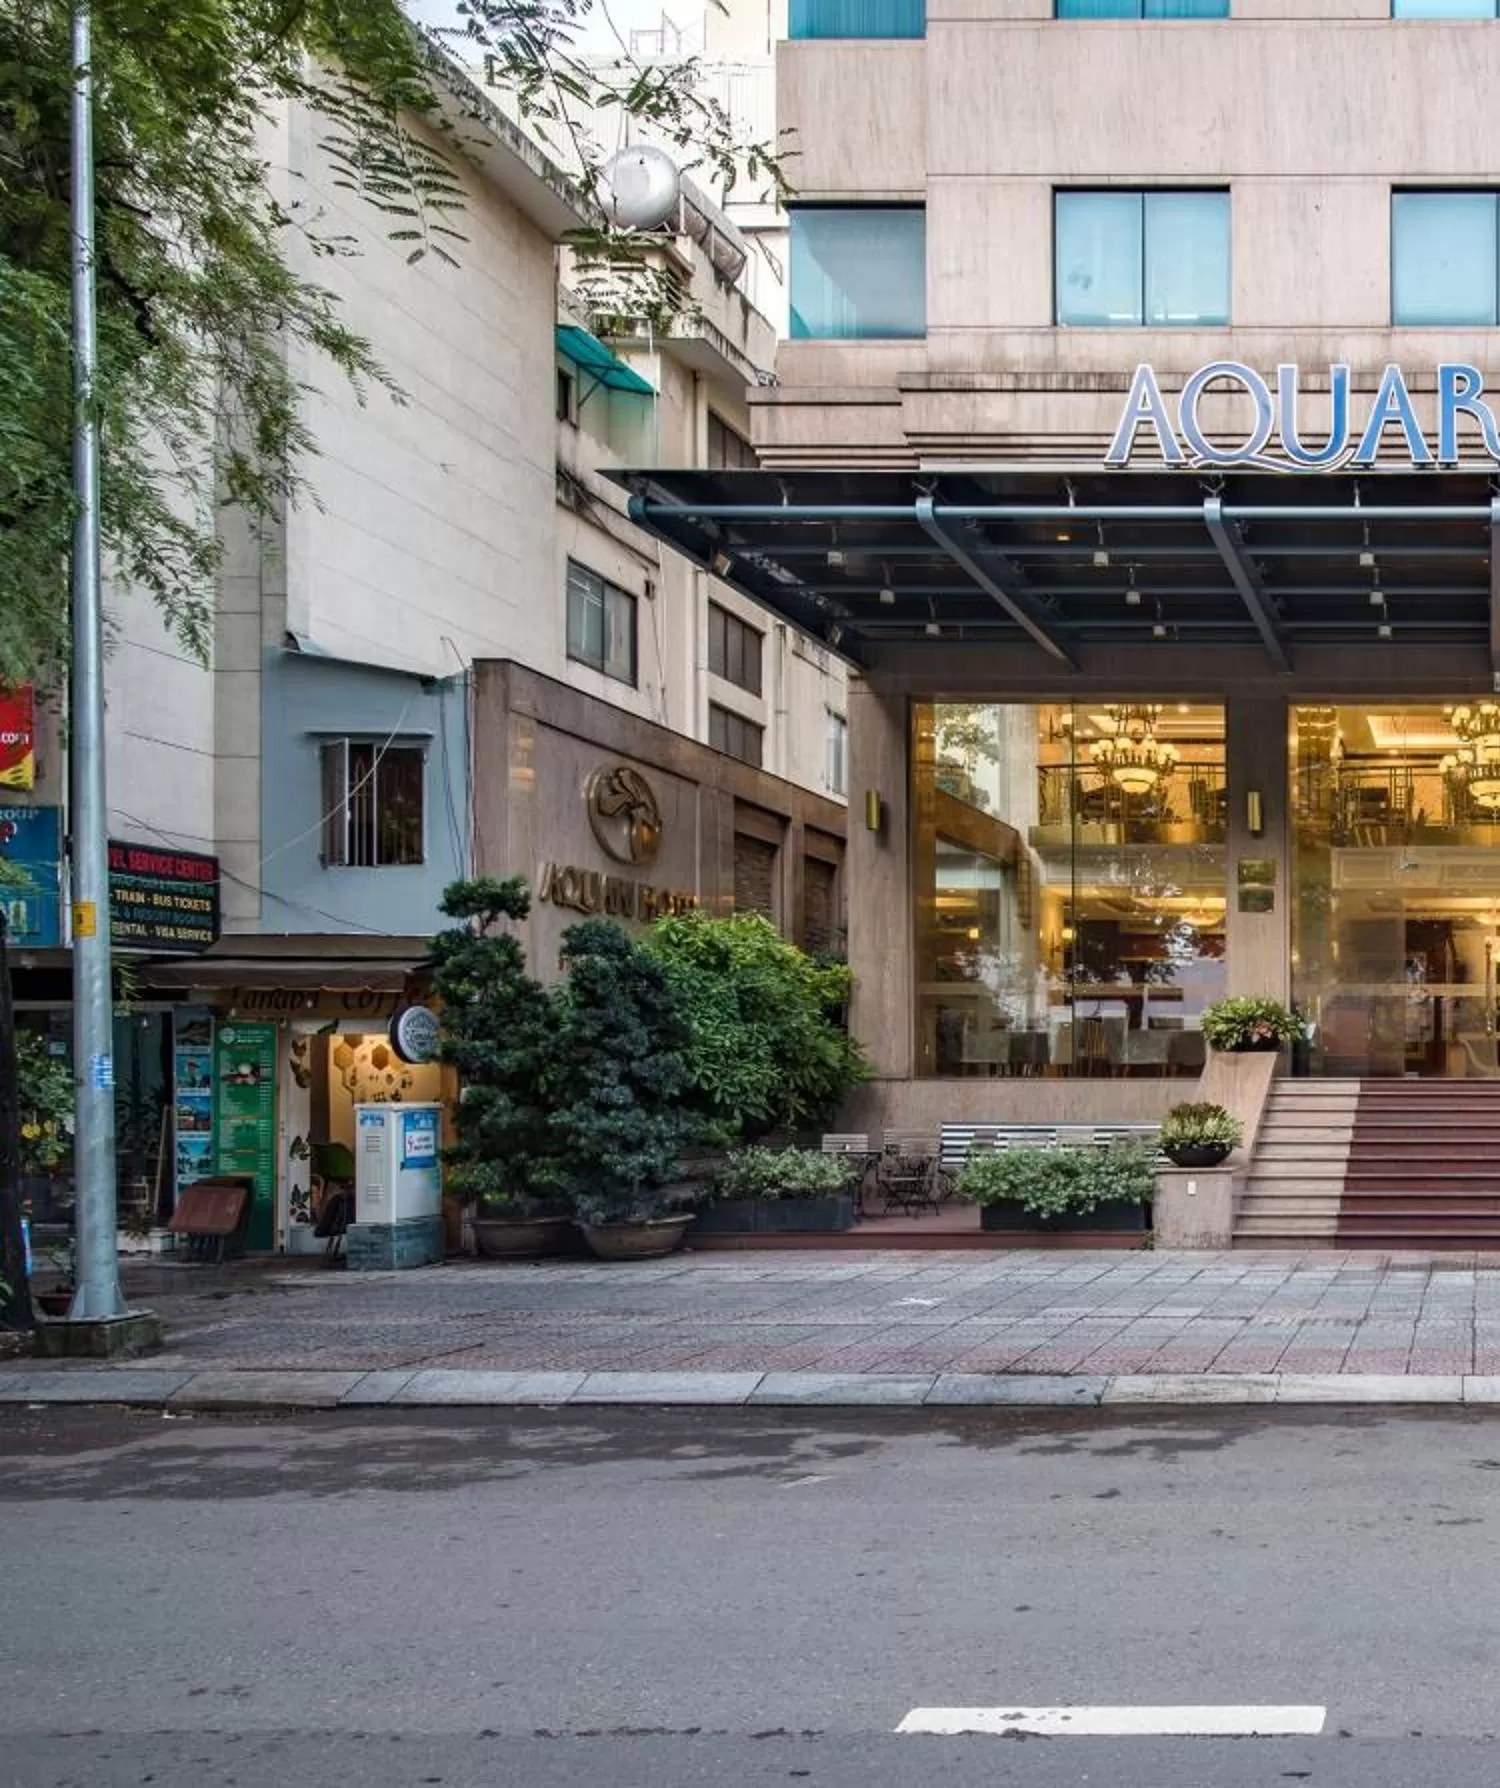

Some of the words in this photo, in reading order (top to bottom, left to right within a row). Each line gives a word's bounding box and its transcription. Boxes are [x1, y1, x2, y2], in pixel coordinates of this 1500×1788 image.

[128, 851, 173, 875] SERVICE
[175, 860, 214, 881] CENTER
[115, 889, 146, 904] TRAIN
[153, 893, 172, 907] BUS
[174, 896, 212, 912] TICKETS
[155, 926, 175, 938] VISA
[176, 928, 213, 941] SERVICE
